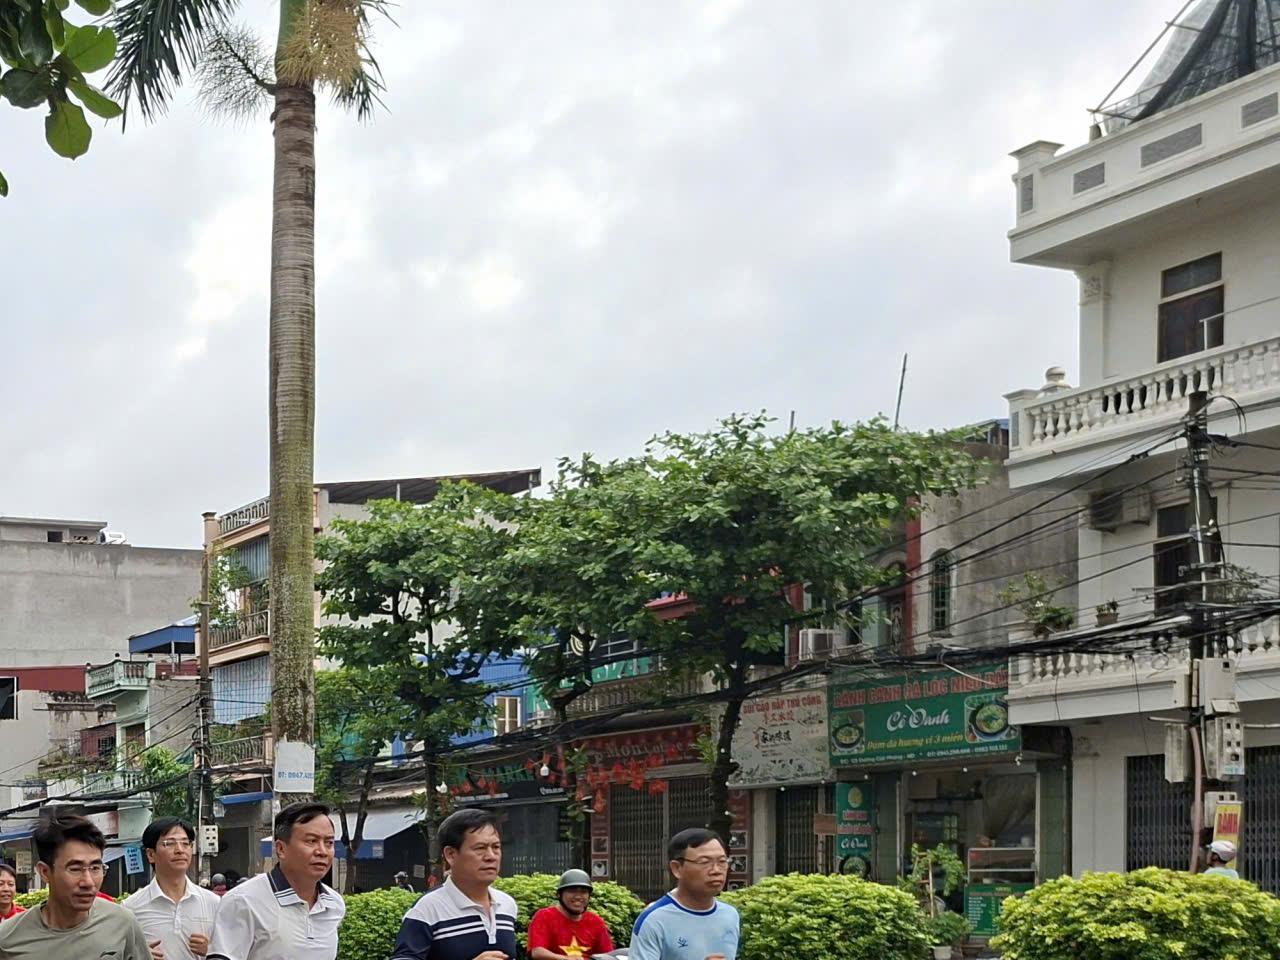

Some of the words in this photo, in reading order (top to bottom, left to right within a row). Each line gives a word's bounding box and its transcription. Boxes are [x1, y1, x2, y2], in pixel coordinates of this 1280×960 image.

[886, 710, 907, 732] Cô
[908, 708, 951, 729] Oanh
[934, 734, 941, 743] 3
